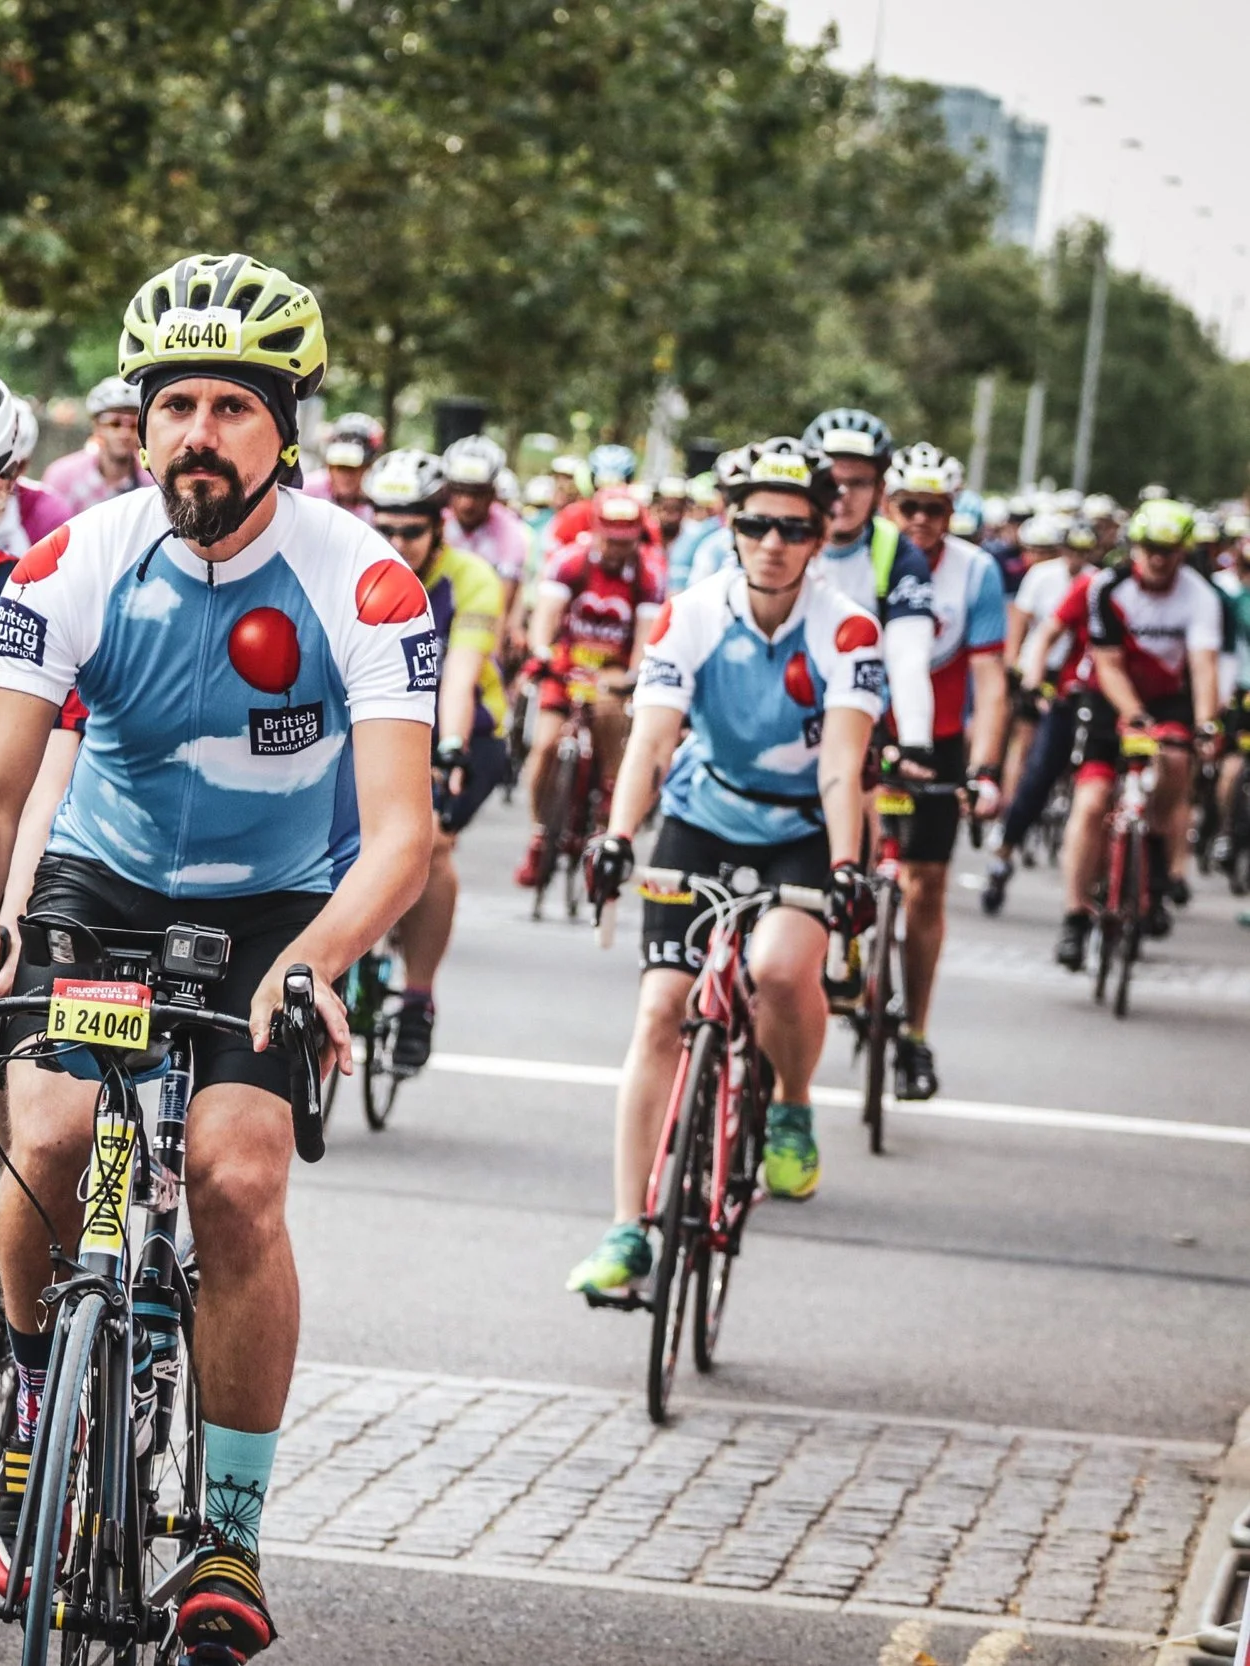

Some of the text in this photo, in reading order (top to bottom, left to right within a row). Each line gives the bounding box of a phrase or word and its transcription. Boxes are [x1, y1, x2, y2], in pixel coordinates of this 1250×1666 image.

[164, 322, 227, 350] 24040
[263, 711, 316, 730] British
[257, 720, 318, 744] Lung
[257, 733, 319, 752] Foundation
[66, 986, 123, 994] PRUDENTIAL
[54, 1009, 143, 1042] B 24040
[100, 1135, 130, 1152] B
